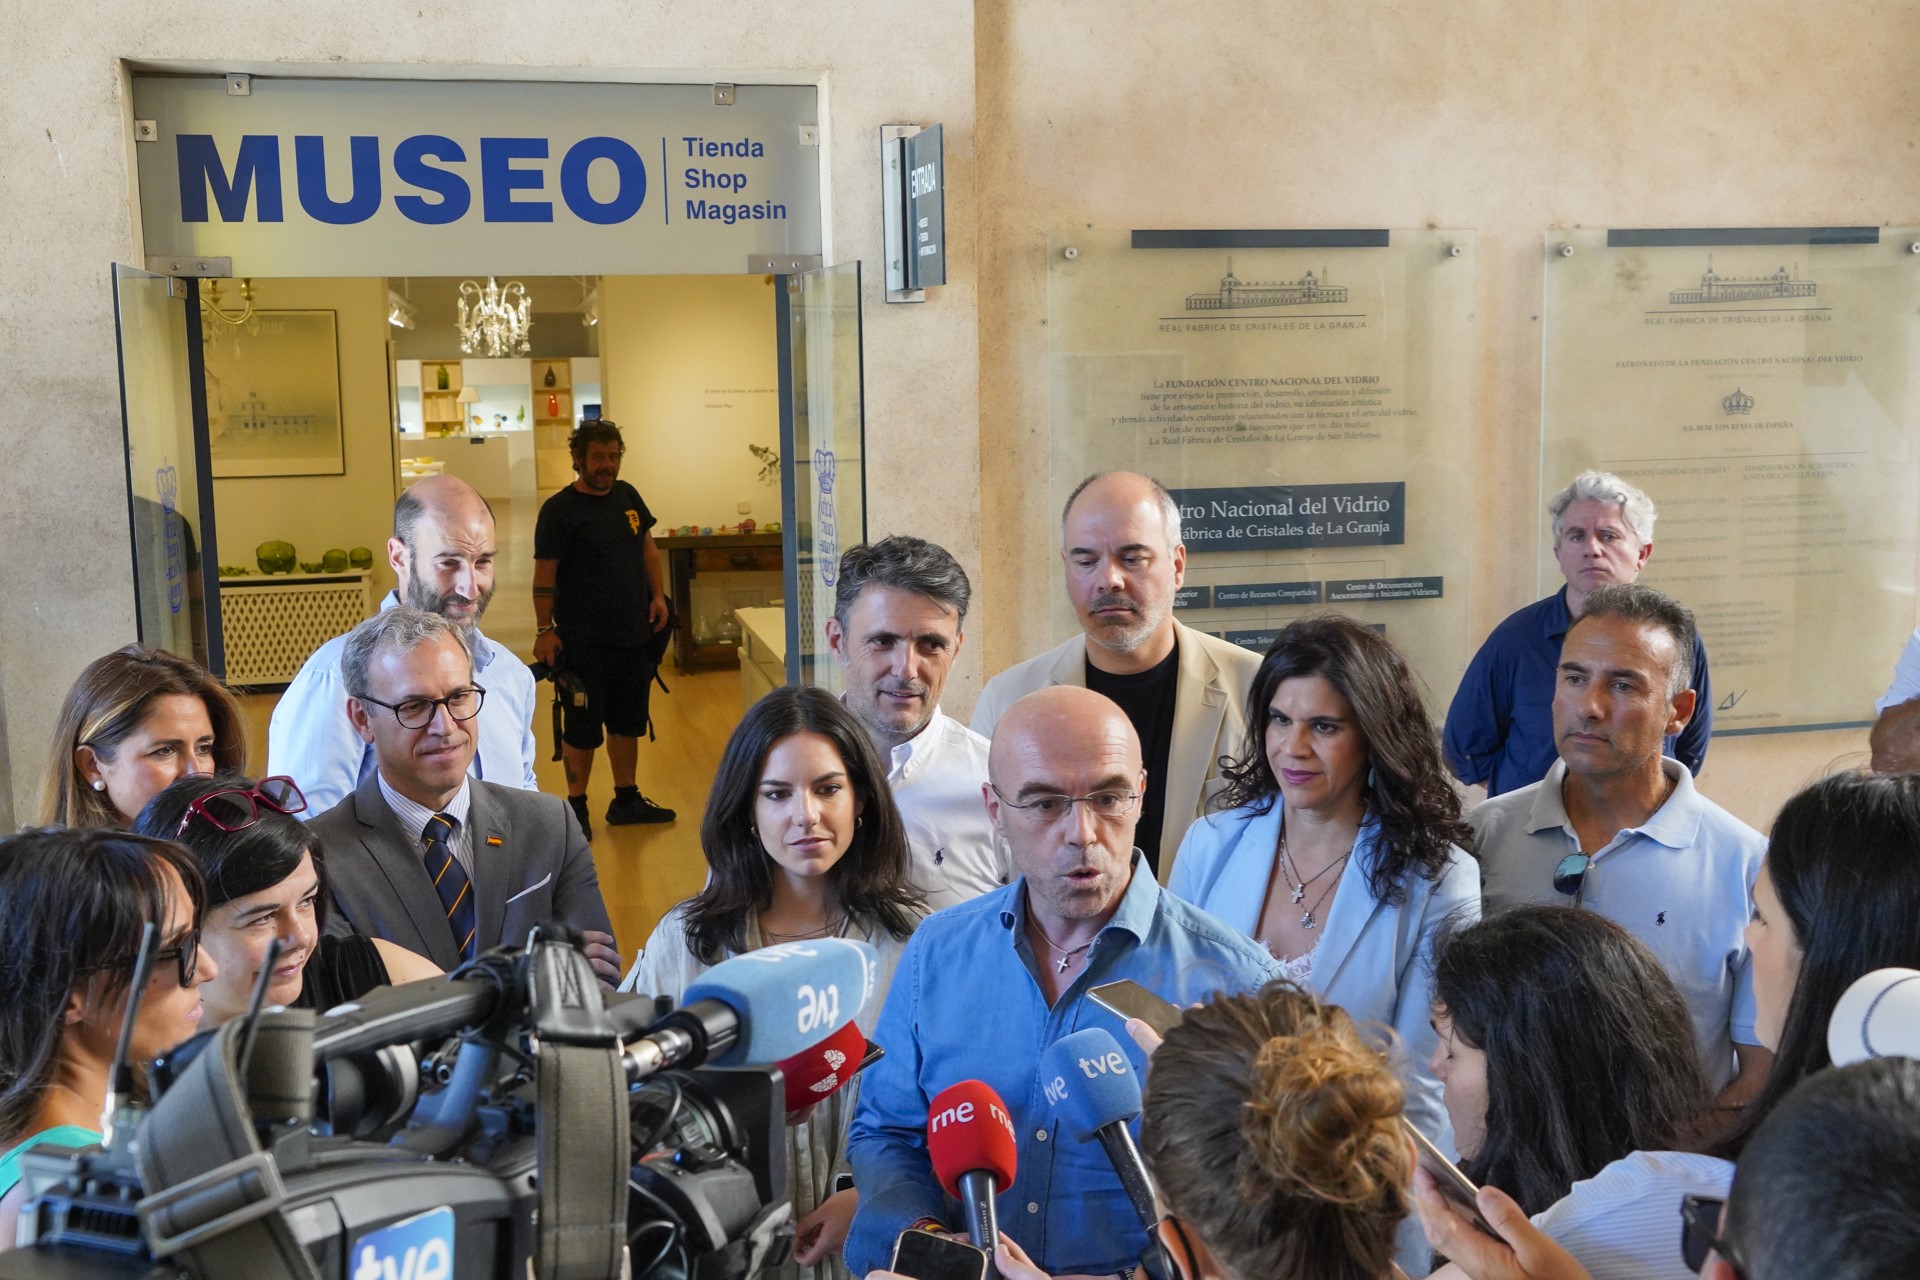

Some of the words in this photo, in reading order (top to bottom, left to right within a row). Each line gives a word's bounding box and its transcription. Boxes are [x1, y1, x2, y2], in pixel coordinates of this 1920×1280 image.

[682, 137, 764, 158] Tienda
[176, 134, 647, 225] MUSEO
[684, 168, 748, 194] Shop
[911, 162, 937, 199] ENTRADA
[686, 200, 787, 225] Magasin
[1159, 324, 1182, 332] REAL
[1186, 323, 1226, 332] FABRICA
[1230, 323, 1242, 331] DE
[1245, 322, 1295, 331] CRISTALES
[1299, 322, 1311, 330] DE
[1314, 321, 1326, 330] LA
[1329, 320, 1367, 330] GRANJA
[1166, 377, 1226, 388] FUNDACIÓN
[1228, 378, 1268, 387] CENTRO
[1271, 376, 1321, 386] NACIONAL
[1324, 376, 1342, 385] DEL
[1345, 375, 1380, 384] VIDRIO
[1179, 504, 1205, 519] tro
[1210, 498, 1293, 518] Nacional
[1299, 497, 1327, 515] del
[1331, 496, 1390, 514] Vidrio
[1182, 526, 1223, 540] ábrica
[1226, 525, 1243, 538] de
[1246, 523, 1304, 538] Cristales
[1307, 522, 1323, 535] de
[1327, 521, 1342, 534] La
[1345, 519, 1391, 537] Granja
[1175, 590, 1199, 600] uperior
[1218, 591, 1239, 600] Centro
[1241, 590, 1249, 599] de
[1250, 589, 1276, 598] Recursos
[1278, 588, 1317, 598] Compartidos
[1346, 583, 1367, 591] Centro
[1368, 582, 1376, 590] de
[1377, 580, 1424, 590] Documentación
[797, 984, 839, 1034] tve
[1079, 1052, 1127, 1079] tve
[931, 1102, 975, 1133] rne
[990, 1103, 1016, 1143] rne
[354, 1237, 452, 1280] tve
